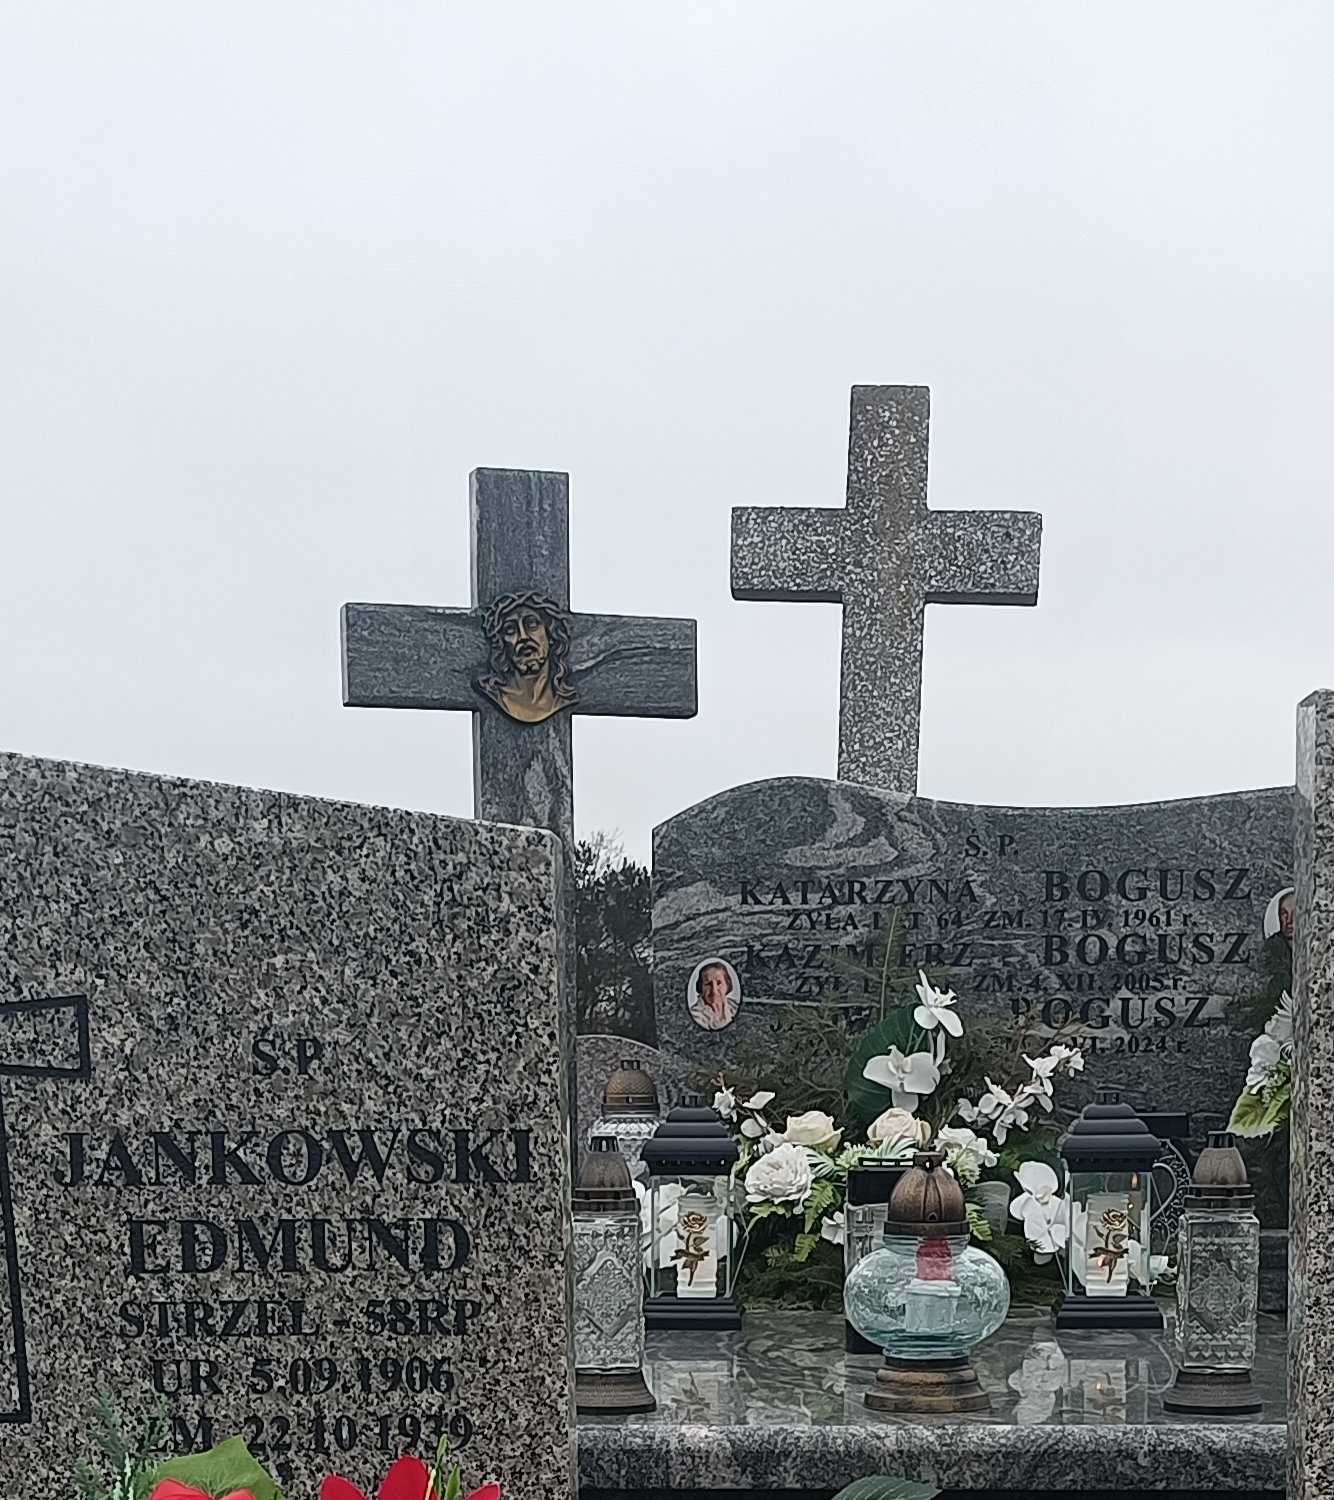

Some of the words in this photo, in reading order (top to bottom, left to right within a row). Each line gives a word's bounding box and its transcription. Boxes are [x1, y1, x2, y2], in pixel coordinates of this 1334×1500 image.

[739, 879, 979, 905] KATARZYNA
[1043, 868, 1252, 902] BOGUSZ
[872, 911, 924, 931] LT
[1122, 908, 1173, 928] 1961
[745, 943, 973, 972] KAZIMERZ
[1042, 932, 1251, 966] BOGUSZ
[1115, 972, 1166, 992] 2005
[1114, 1036, 1168, 1054] 2024
[53, 1128, 537, 1187] JANKOWSKI
[128, 1217, 471, 1275] EDMUND
